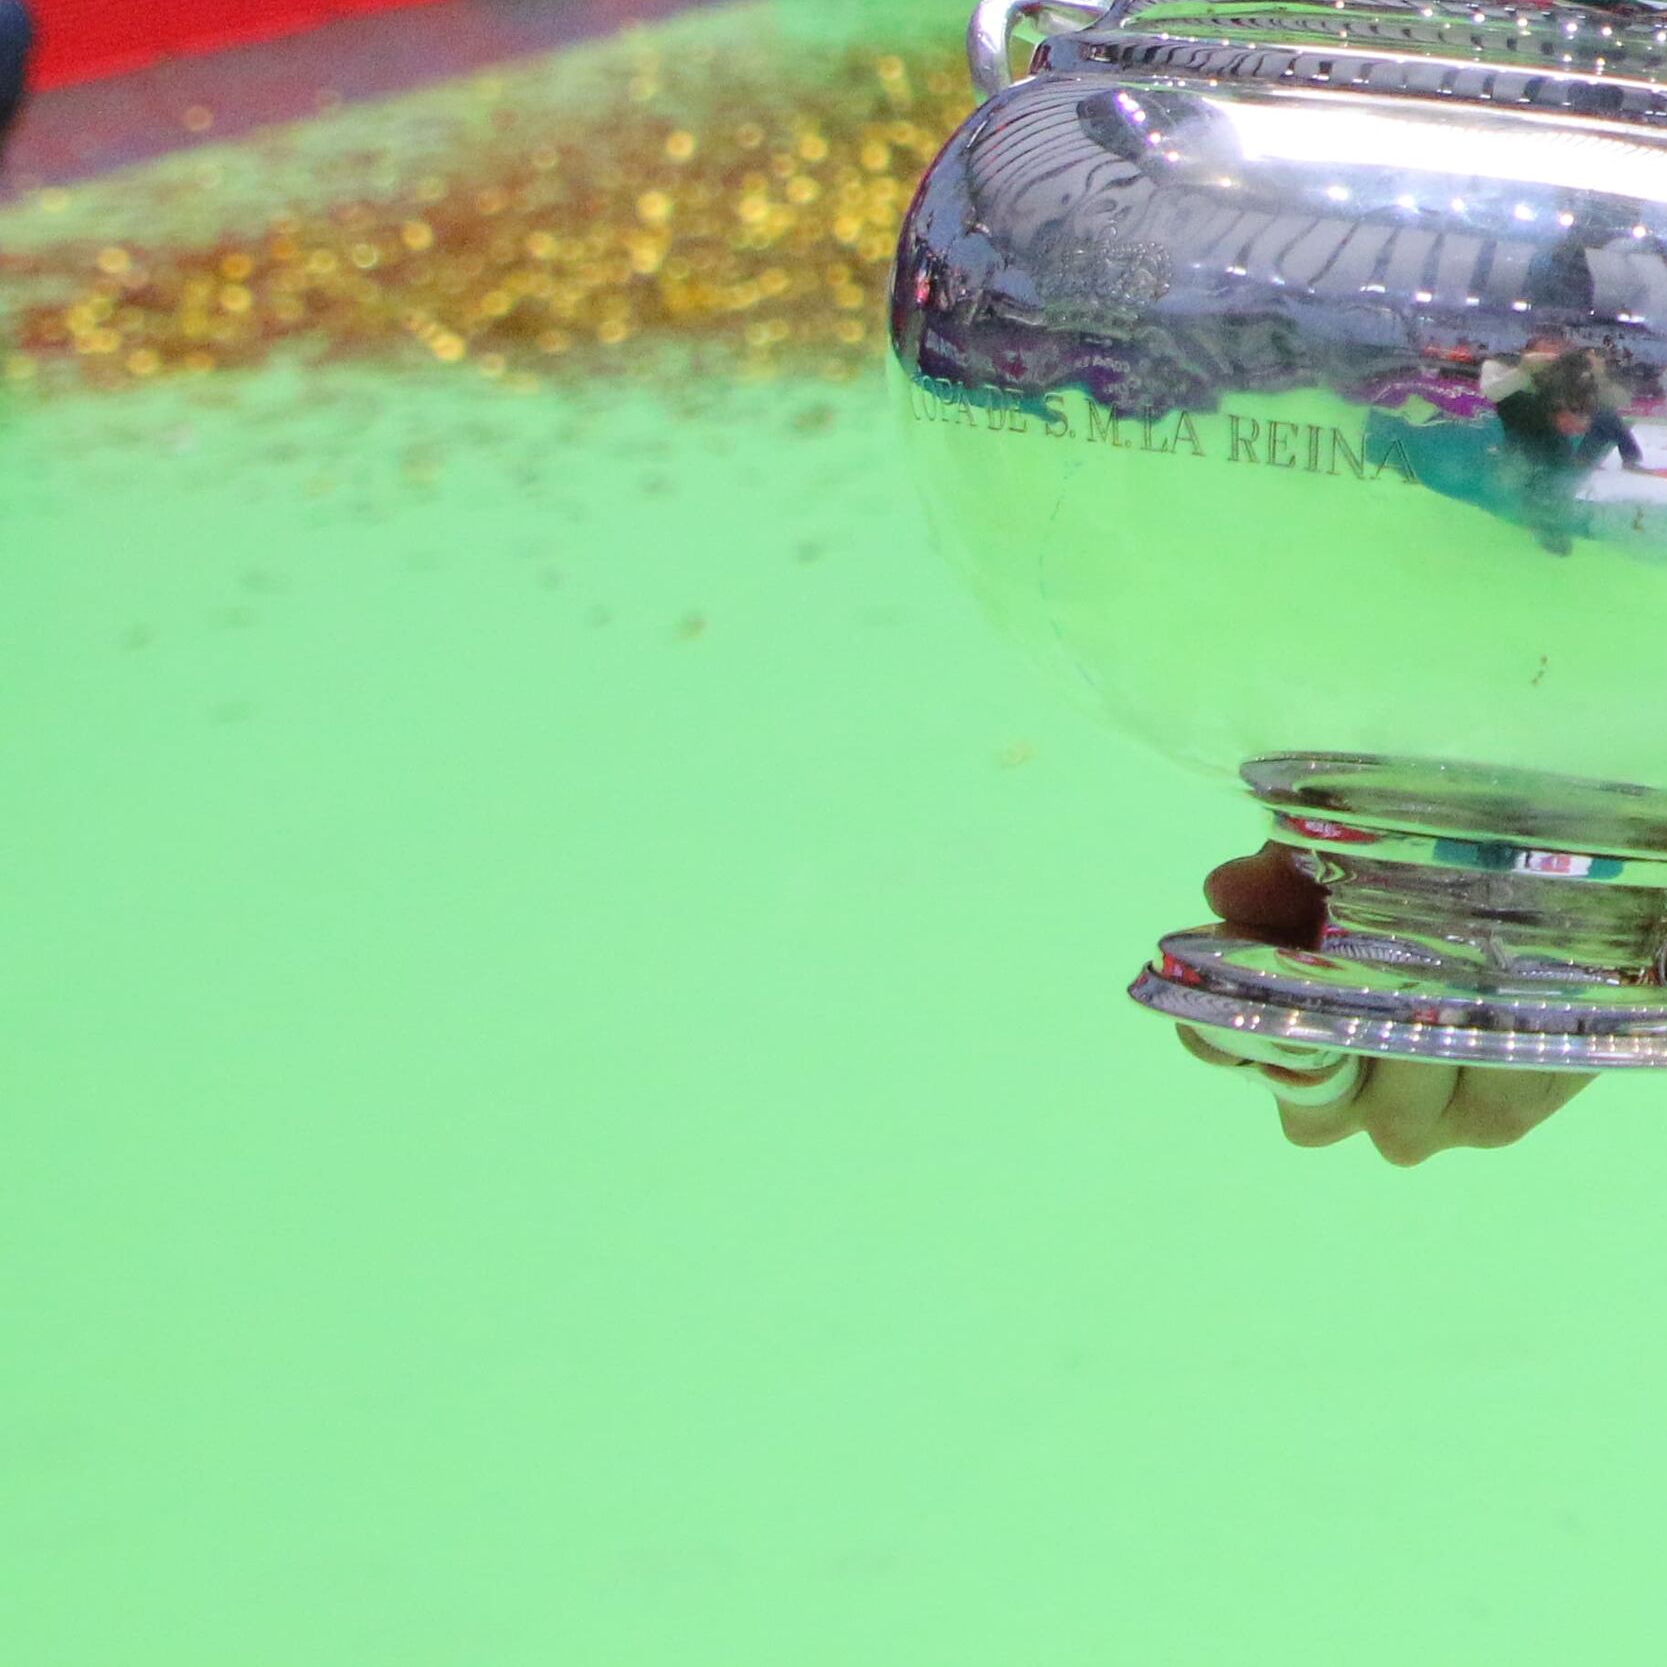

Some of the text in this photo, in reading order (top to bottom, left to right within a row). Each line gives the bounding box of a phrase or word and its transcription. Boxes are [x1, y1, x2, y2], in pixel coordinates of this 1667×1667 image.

[983, 384, 1028, 433] DE
[1139, 402, 1207, 457] LA
[1226, 412, 1424, 486] REINA
